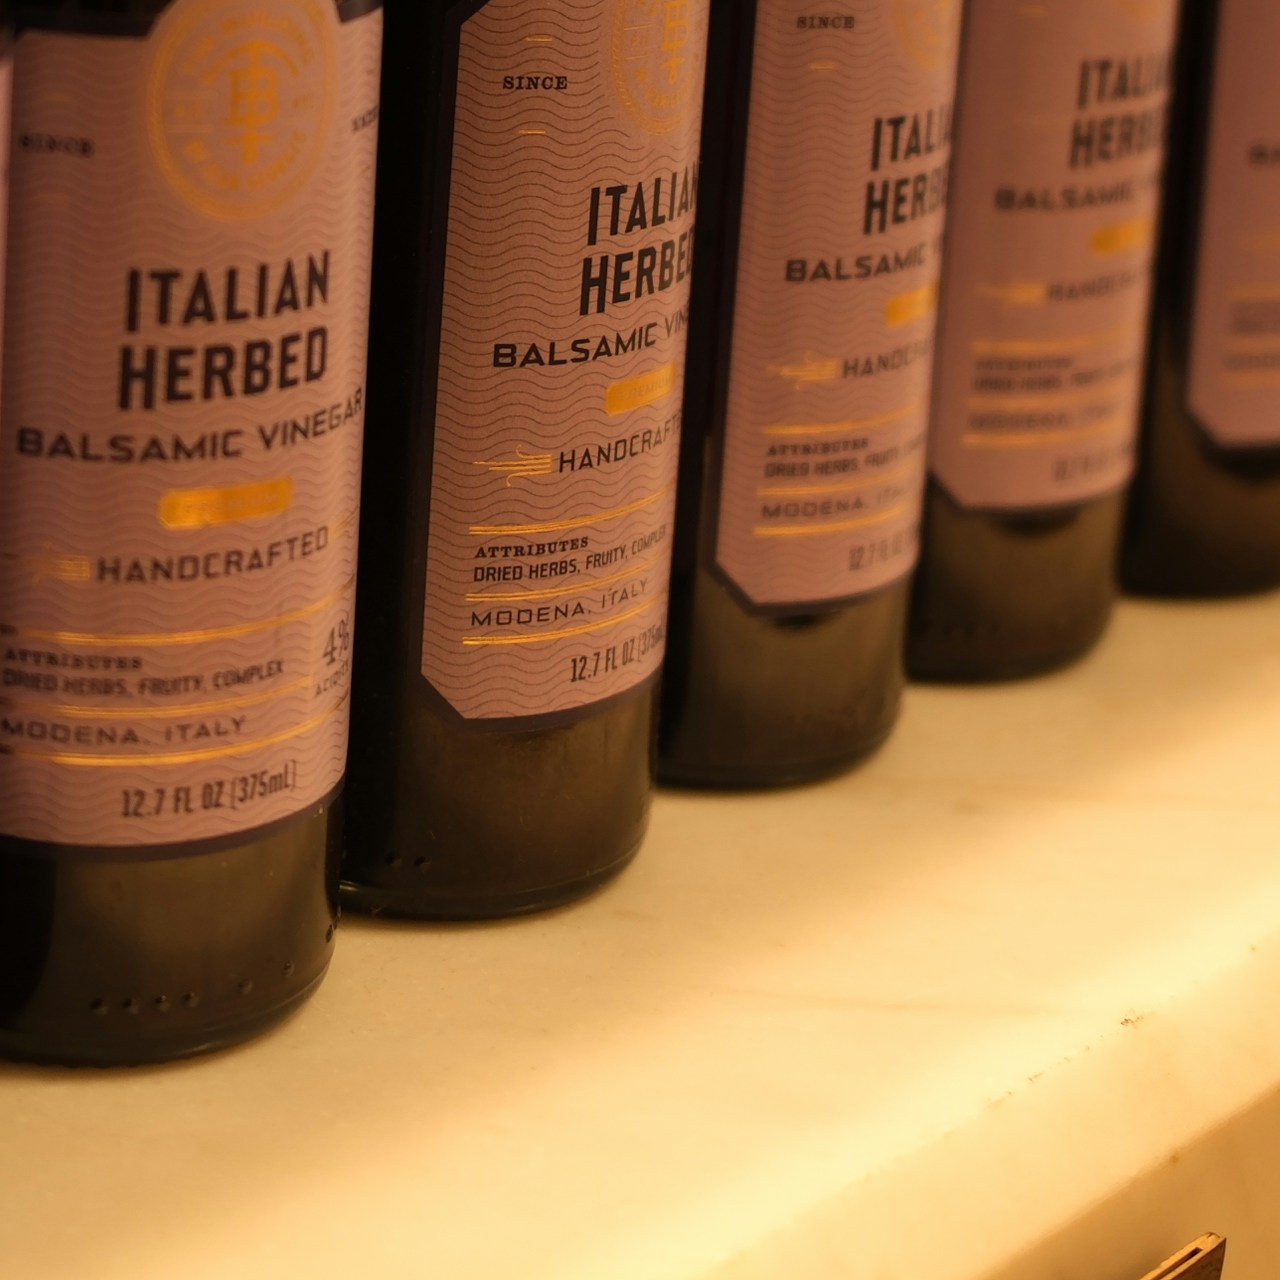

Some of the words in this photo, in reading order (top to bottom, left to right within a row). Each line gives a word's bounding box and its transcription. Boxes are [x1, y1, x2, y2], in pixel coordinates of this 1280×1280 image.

[796, 16, 855, 30] SINCE
[503, 75, 568, 90] SINCE
[785, 243, 928, 282] BALSAMIC
[126, 251, 330, 334] ITALIAN
[493, 322, 658, 368] BALSAMIC
[119, 325, 329, 411] HERBED
[16, 426, 244, 464] BALSAMIC
[259, 386, 363, 450] VINEGAR
[96, 526, 329, 583] HANDCRAFTED
[474, 566, 523, 582] DRIED
[529, 560, 580, 581] HERBS,
[586, 546, 628, 570] FRUITY,
[475, 536, 589, 558] ATTRIBUTES
[471, 601, 591, 627] MODENA,
[602, 577, 648, 609] ITALY
[3, 671, 60, 692] DRIED
[65, 673, 131, 697] HERBS,
[138, 669, 207, 696] FRUITY,
[214, 659, 285, 691] COMPLEX
[5, 647, 143, 671] ATTRIBUTES
[570, 652, 601, 683] 12.7
[605, 643, 617, 673] FL
[622, 638, 635, 666] OZ
[165, 716, 245, 743] ITALY
[122, 788, 165, 817] 12.7
[173, 785, 195, 813] FL
[202, 781, 224, 809] OZ
